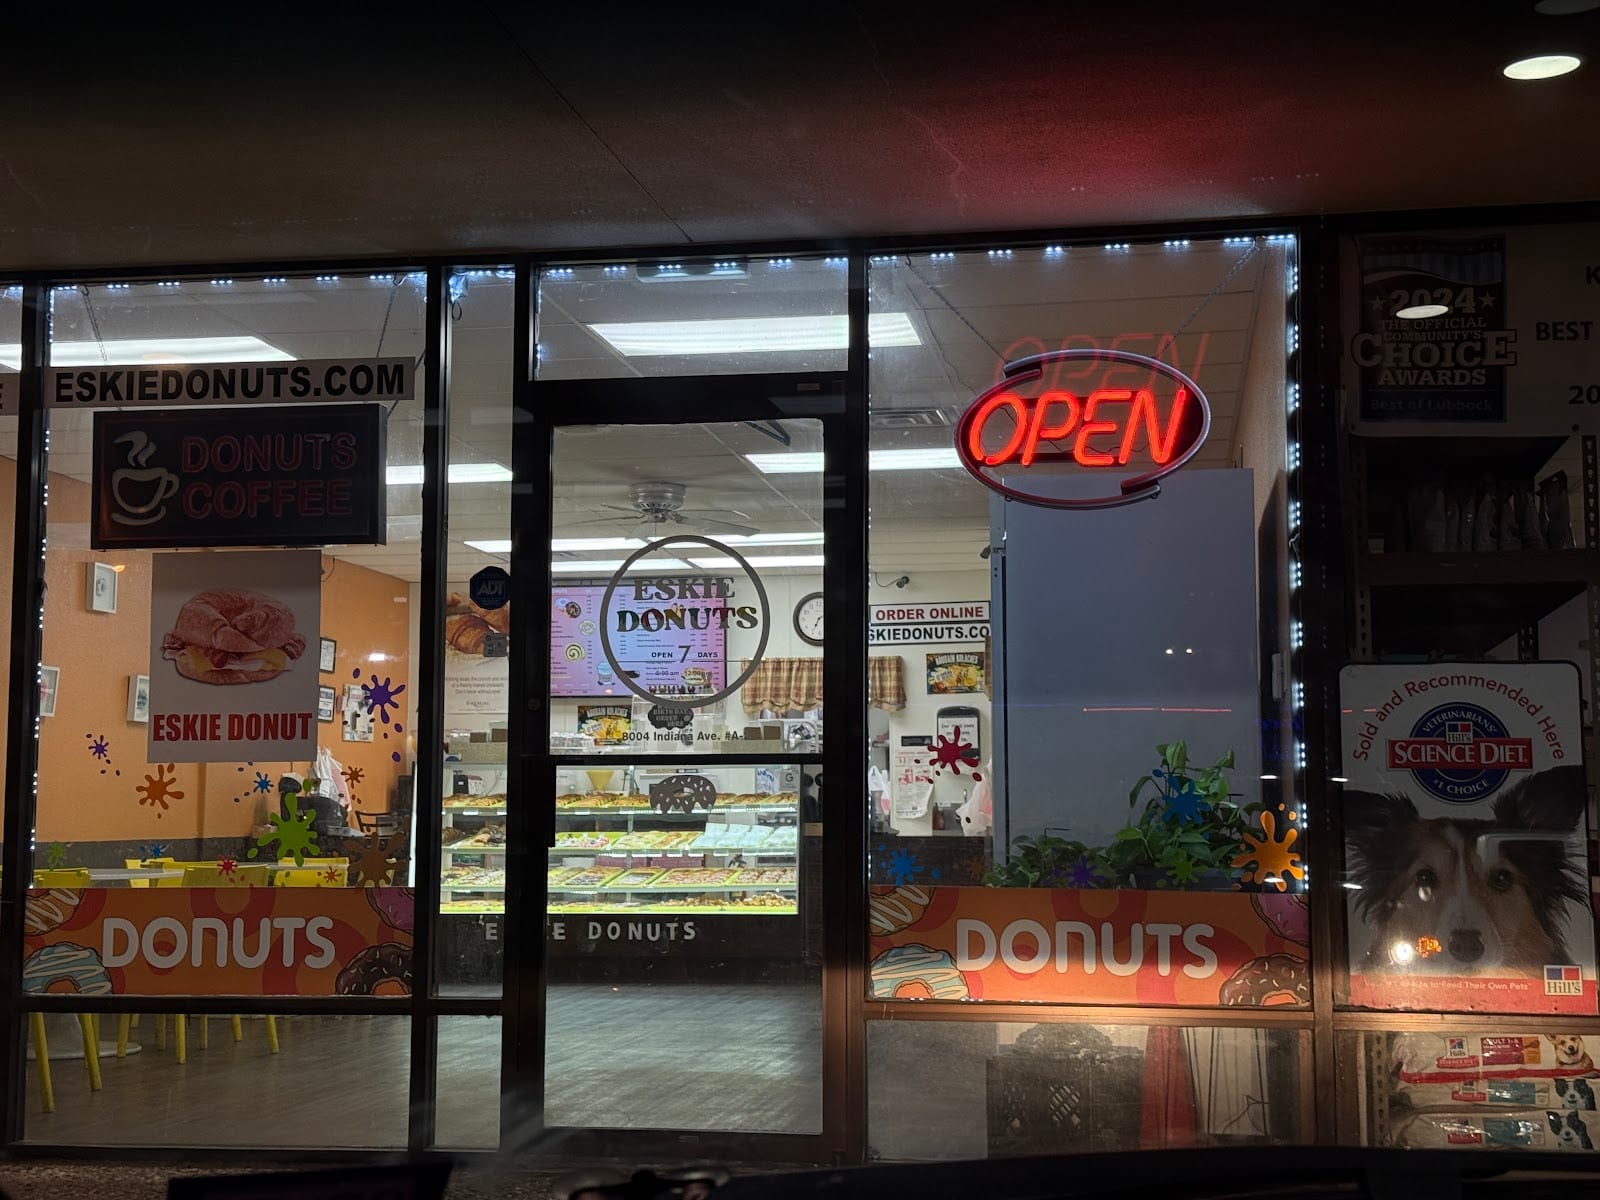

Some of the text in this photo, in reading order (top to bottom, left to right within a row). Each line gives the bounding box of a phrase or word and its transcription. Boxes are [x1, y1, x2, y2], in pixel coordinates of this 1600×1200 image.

[1382, 316, 1488, 331] THE OFFICIAL
[1536, 321, 1593, 340] BEST
[1383, 330, 1482, 342] COMMUNITY'S
[1353, 329, 1518, 369] CHOICE
[56, 364, 405, 402] ESKIEDONUTS.COM
[1376, 368, 1488, 386] AWARDS
[1370, 399, 1494, 411] Best of Lubbock
[968, 387, 1187, 467] OPEN
[181, 432, 358, 473] DONUTS
[182, 479, 353, 519] COFFEE
[478, 579, 505, 596] ADT
[632, 577, 736, 601] ESKIE
[616, 606, 759, 633] DONUTS
[876, 606, 984, 621] ORDER ONLINE
[678, 645, 691, 664] 7
[153, 712, 312, 741] ESKIE DONUT
[1353, 674, 1565, 761] Sold and Recommended Here
[622, 730, 650, 741] 8004
[653, 730, 694, 741] Indiana
[697, 730, 721, 741] Ave.
[1394, 742, 1526, 765] SCIENCE DIET
[1446, 778, 1490, 795] CHOICE
[588, 921, 697, 941] DONUTS
[102, 916, 336, 969] DONUTS
[956, 918, 1219, 979] DONUTS
[1464, 981, 1486, 990] Their
[1488, 982, 1508, 991] Own
[1510, 982, 1528, 991] Pets
[1546, 980, 1581, 994] Hill's
